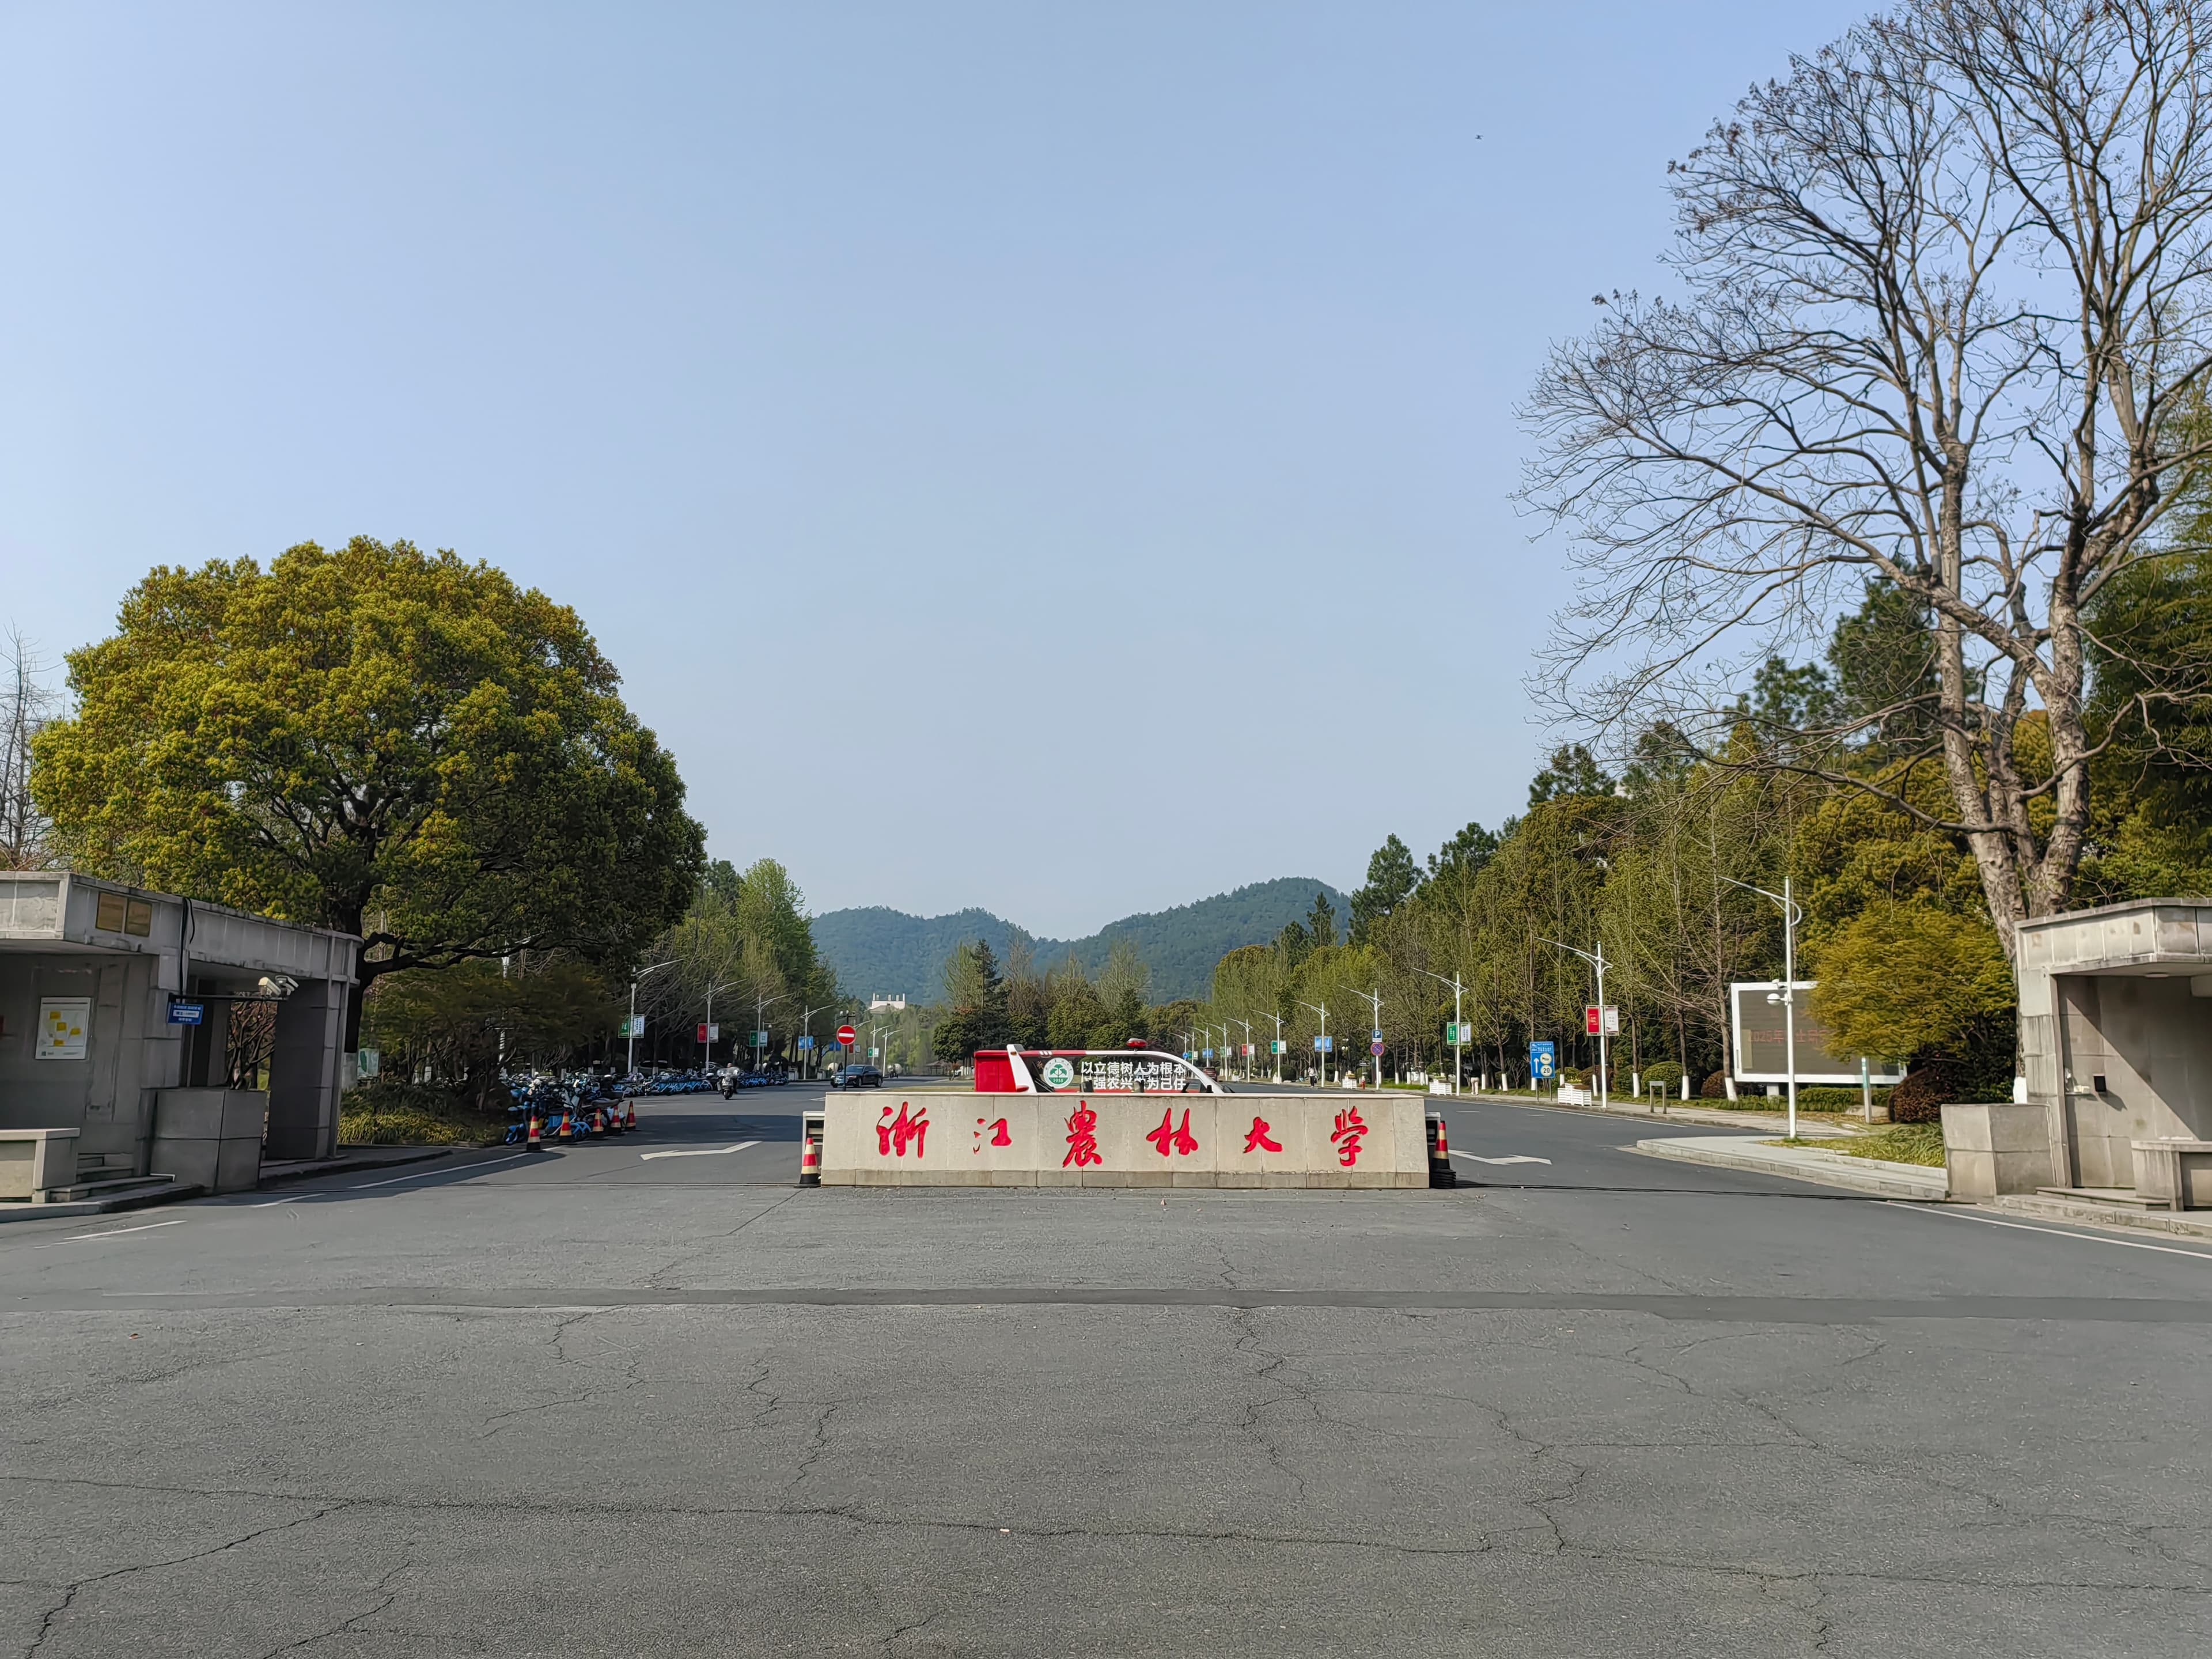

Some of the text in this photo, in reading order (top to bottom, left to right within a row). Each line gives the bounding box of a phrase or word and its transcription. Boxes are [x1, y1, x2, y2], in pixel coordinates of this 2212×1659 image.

[1081, 1061, 1185, 1075] 以立德树人为根本
[1081, 1076, 1185, 1090] 强农兴为己任
